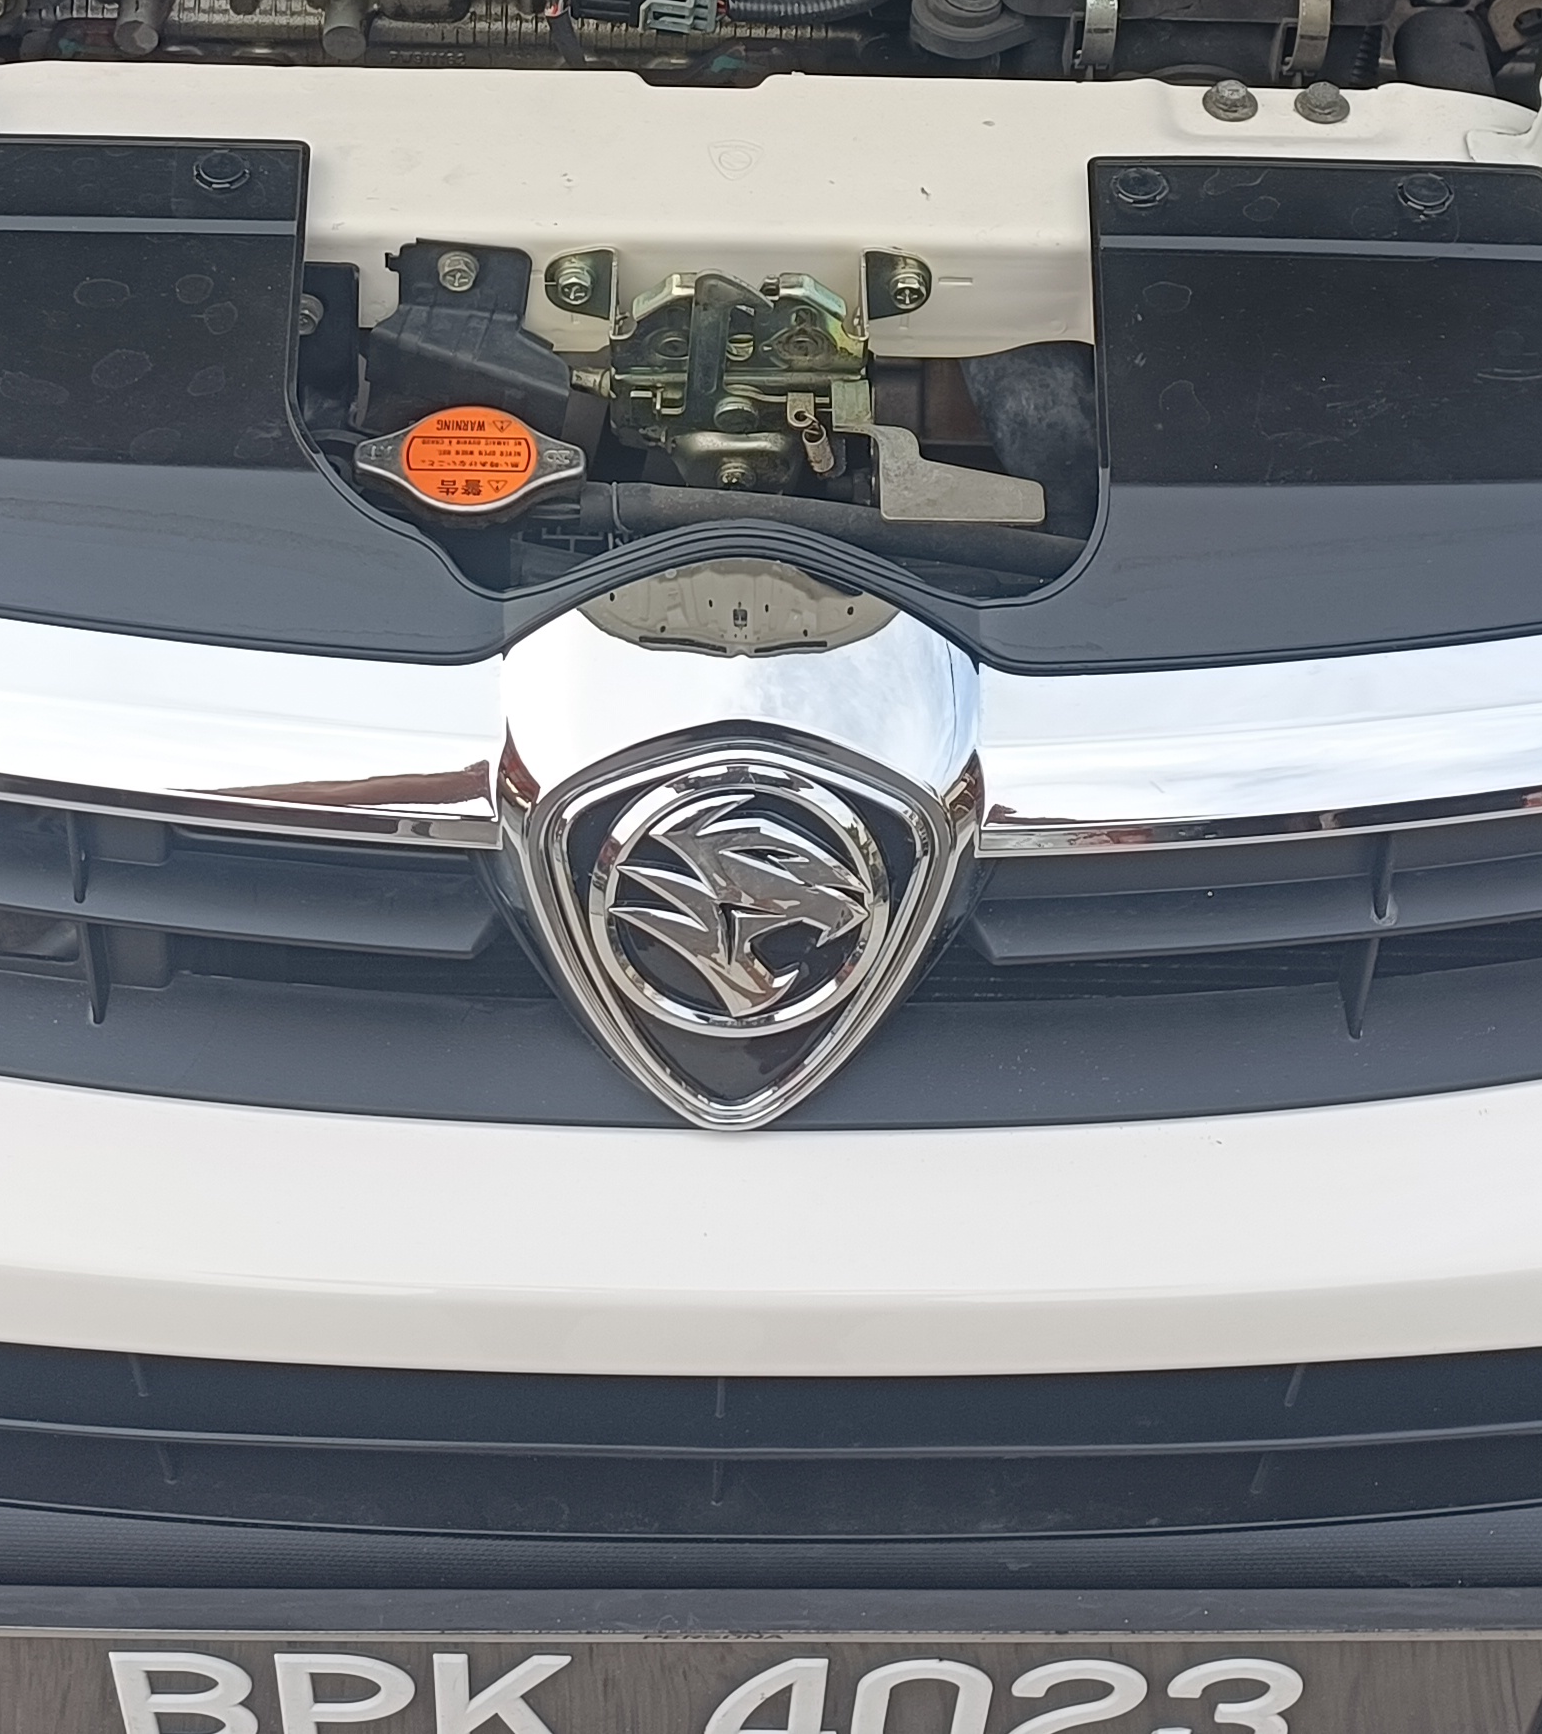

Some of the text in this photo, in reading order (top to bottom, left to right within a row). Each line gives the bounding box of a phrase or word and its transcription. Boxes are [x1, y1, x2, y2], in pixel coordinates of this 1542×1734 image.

[436, 419, 485, 431] WARNING
[436, 479, 483, 496] 警告
[108, 1651, 1304, 1734] BPK 4023
